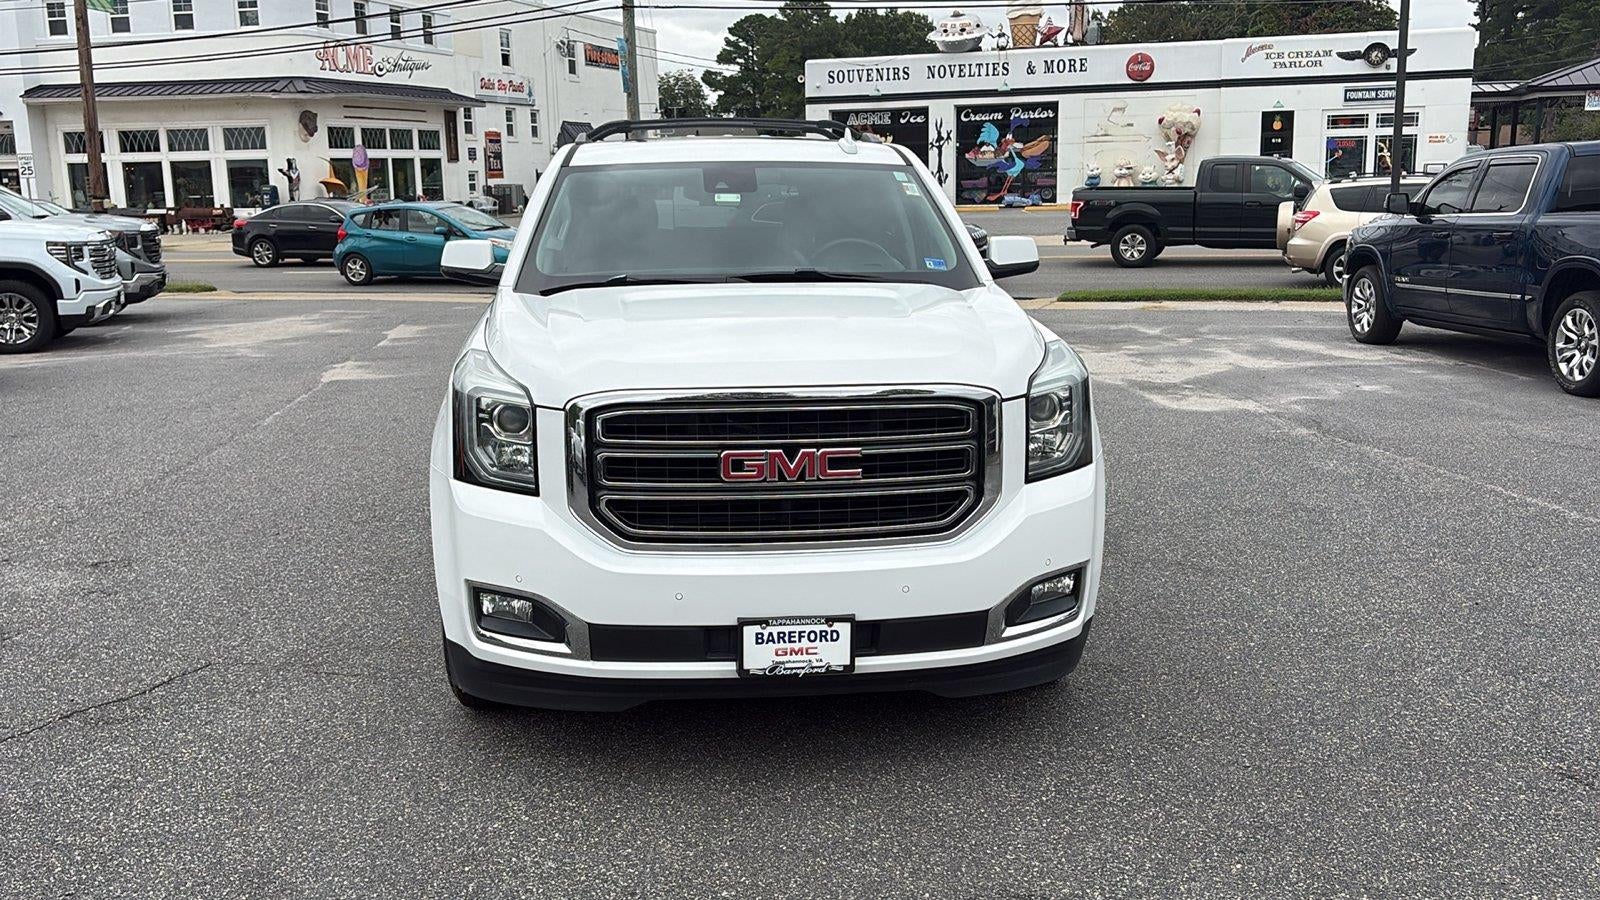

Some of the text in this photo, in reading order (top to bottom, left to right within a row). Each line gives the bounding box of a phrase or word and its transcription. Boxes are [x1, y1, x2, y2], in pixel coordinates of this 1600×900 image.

[315, 41, 375, 76] ACME
[387, 50, 432, 79] Antiques
[1265, 49, 1333, 60] ICE CREAM
[827, 58, 1088, 84] SOUVENIRS NOVELTIES & MORE
[1272, 60, 1323, 69] PARLOR
[1346, 91, 1376, 100] FOUNTAIN
[847, 111, 926, 126] ACME Ice
[960, 107, 1055, 122] Cream Parlor
[20, 166, 34, 176] 25
[720, 447, 863, 482] GMC
[768, 617, 826, 626] TAPPAHANNOCK
[754, 629, 841, 646] BAREFORD
[774, 646, 819, 657] GMC
[765, 661, 831, 678] Bareford
